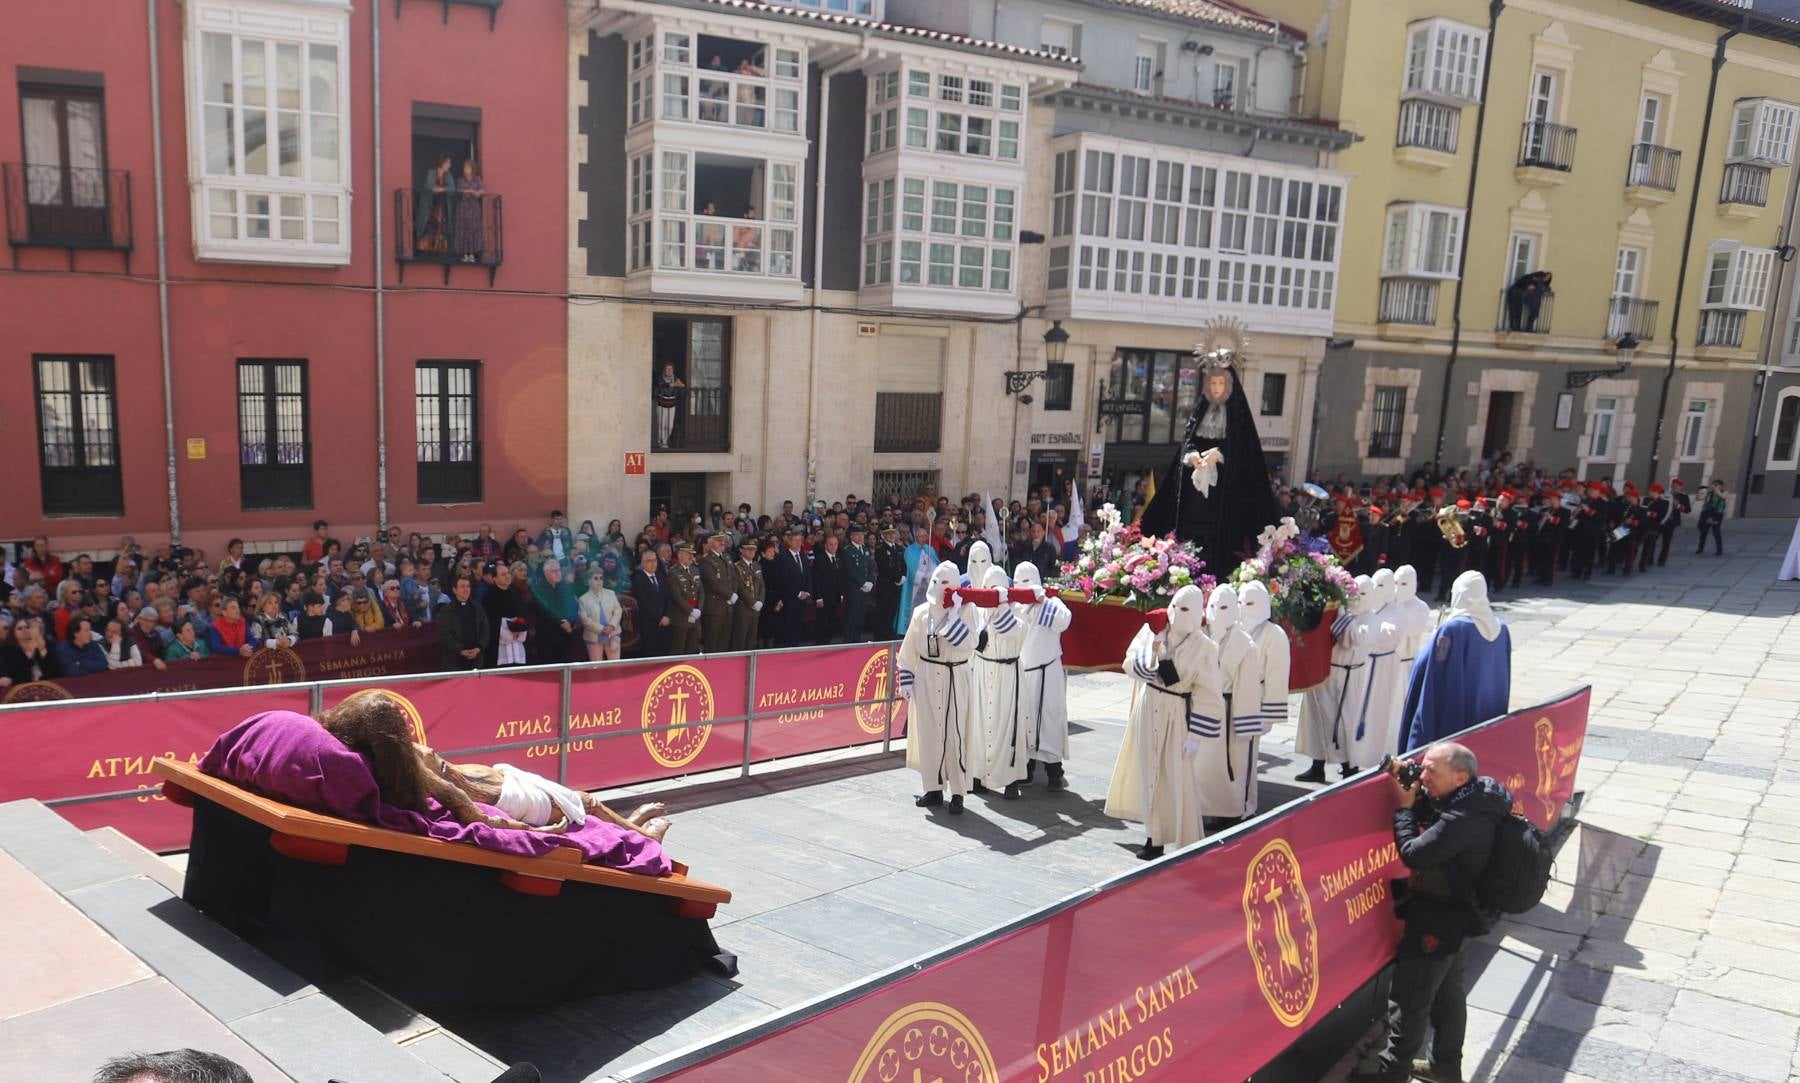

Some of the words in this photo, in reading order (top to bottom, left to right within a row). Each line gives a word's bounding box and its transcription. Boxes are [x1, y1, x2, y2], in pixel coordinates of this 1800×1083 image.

[1031, 433, 1046, 444] ART
[626, 454, 644, 466] AT
[320, 656, 367, 672] SEMANA
[369, 650, 406, 664] SANTA
[341, 665, 387, 679] BURGOS
[1320, 857, 1366, 903] SEMANA
[1345, 878, 1385, 925] BURGOS
[1036, 1002, 1133, 1083] SEMANA
[1135, 964, 1199, 1024] SANTA
